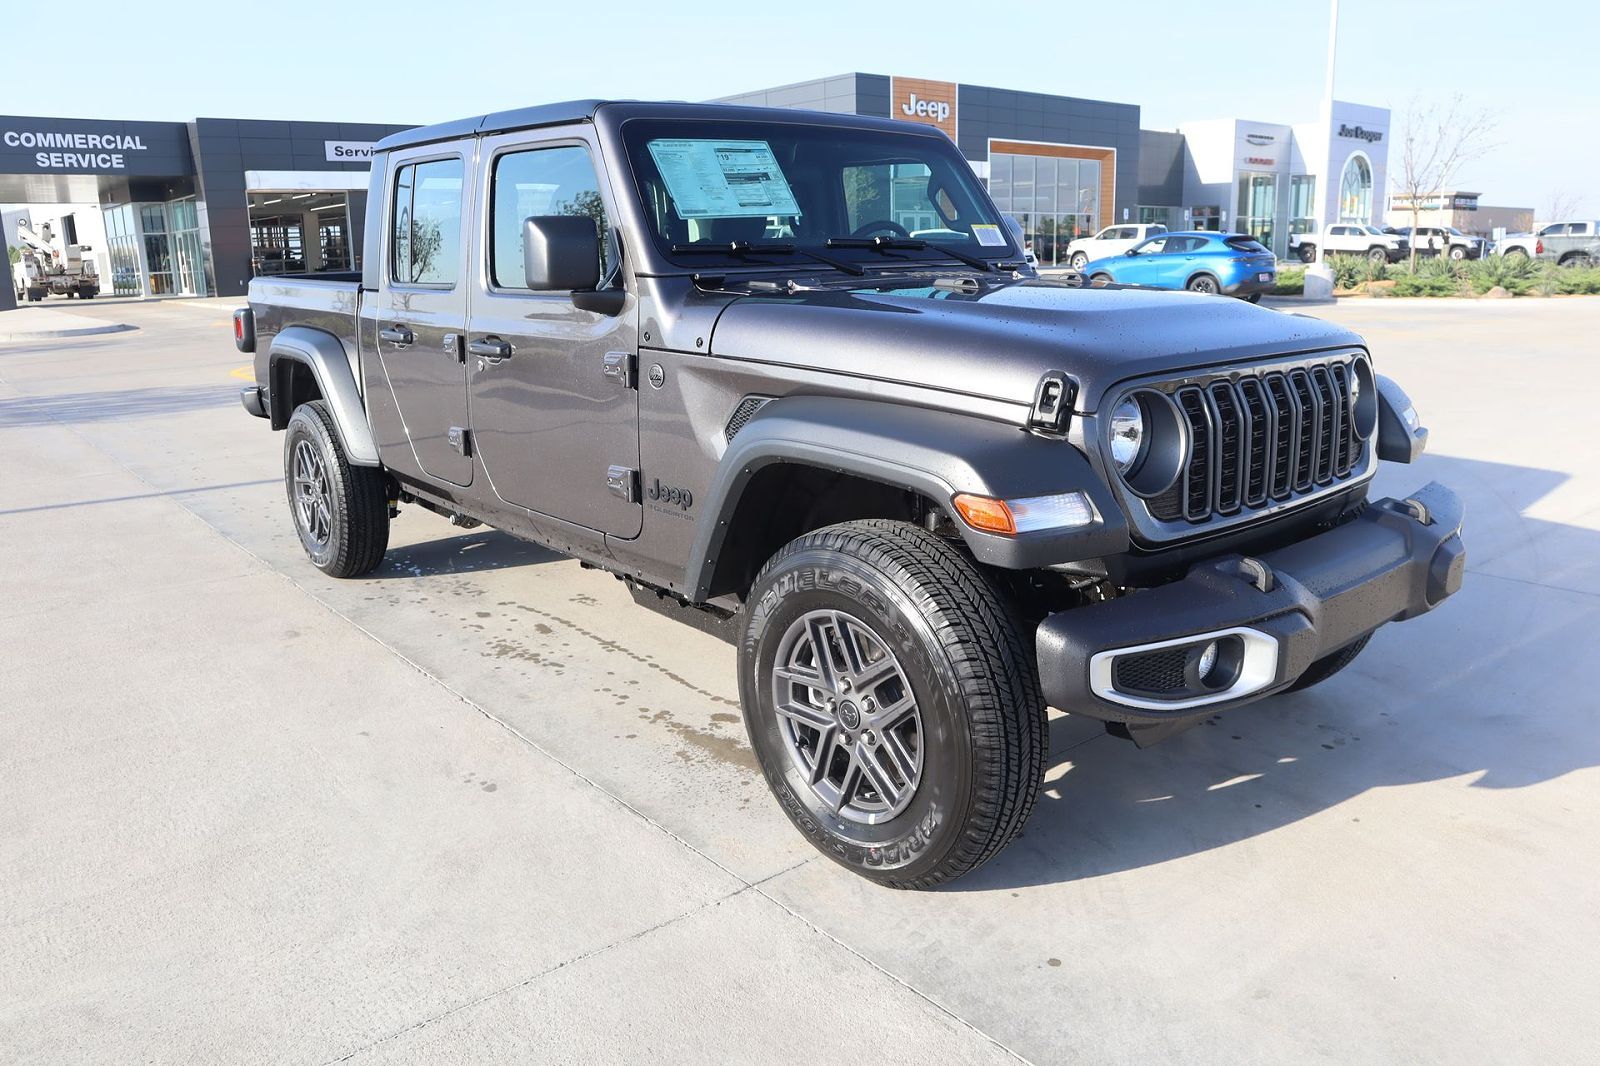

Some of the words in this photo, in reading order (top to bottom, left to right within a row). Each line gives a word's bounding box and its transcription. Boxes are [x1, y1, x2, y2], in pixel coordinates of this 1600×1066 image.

[902, 93, 949, 122] Jeep
[4, 131, 147, 150] COMMERCIAL
[36, 152, 125, 168] SERVICE
[334, 146, 375, 157] Servi
[648, 478, 693, 511] Jeep
